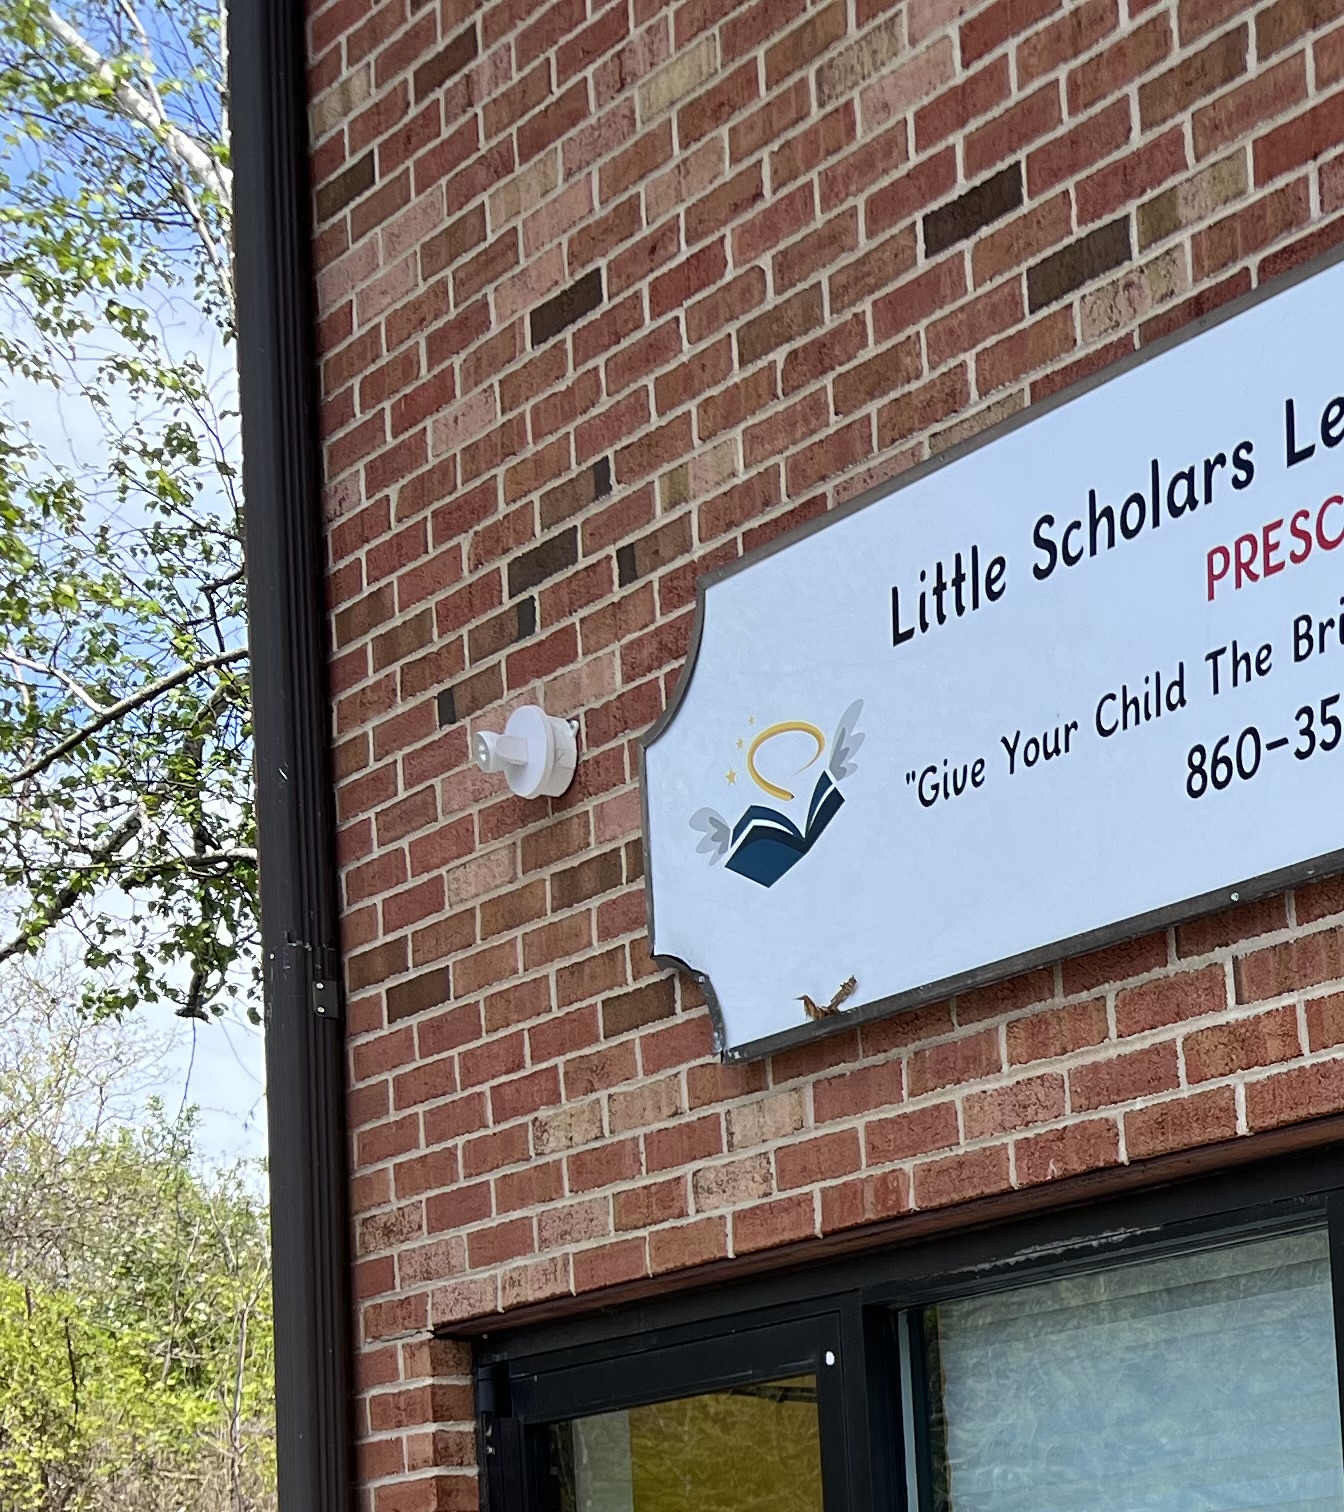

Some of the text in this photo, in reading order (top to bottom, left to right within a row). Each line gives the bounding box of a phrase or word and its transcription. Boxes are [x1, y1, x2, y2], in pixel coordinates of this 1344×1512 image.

[891, 544, 1007, 648] Little
[1032, 440, 1255, 581] Scholars
[905, 757, 986, 809] "Give
[1000, 719, 1079, 775] Your
[1095, 661, 1188, 739] Child
[1204, 639, 1273, 697] The
